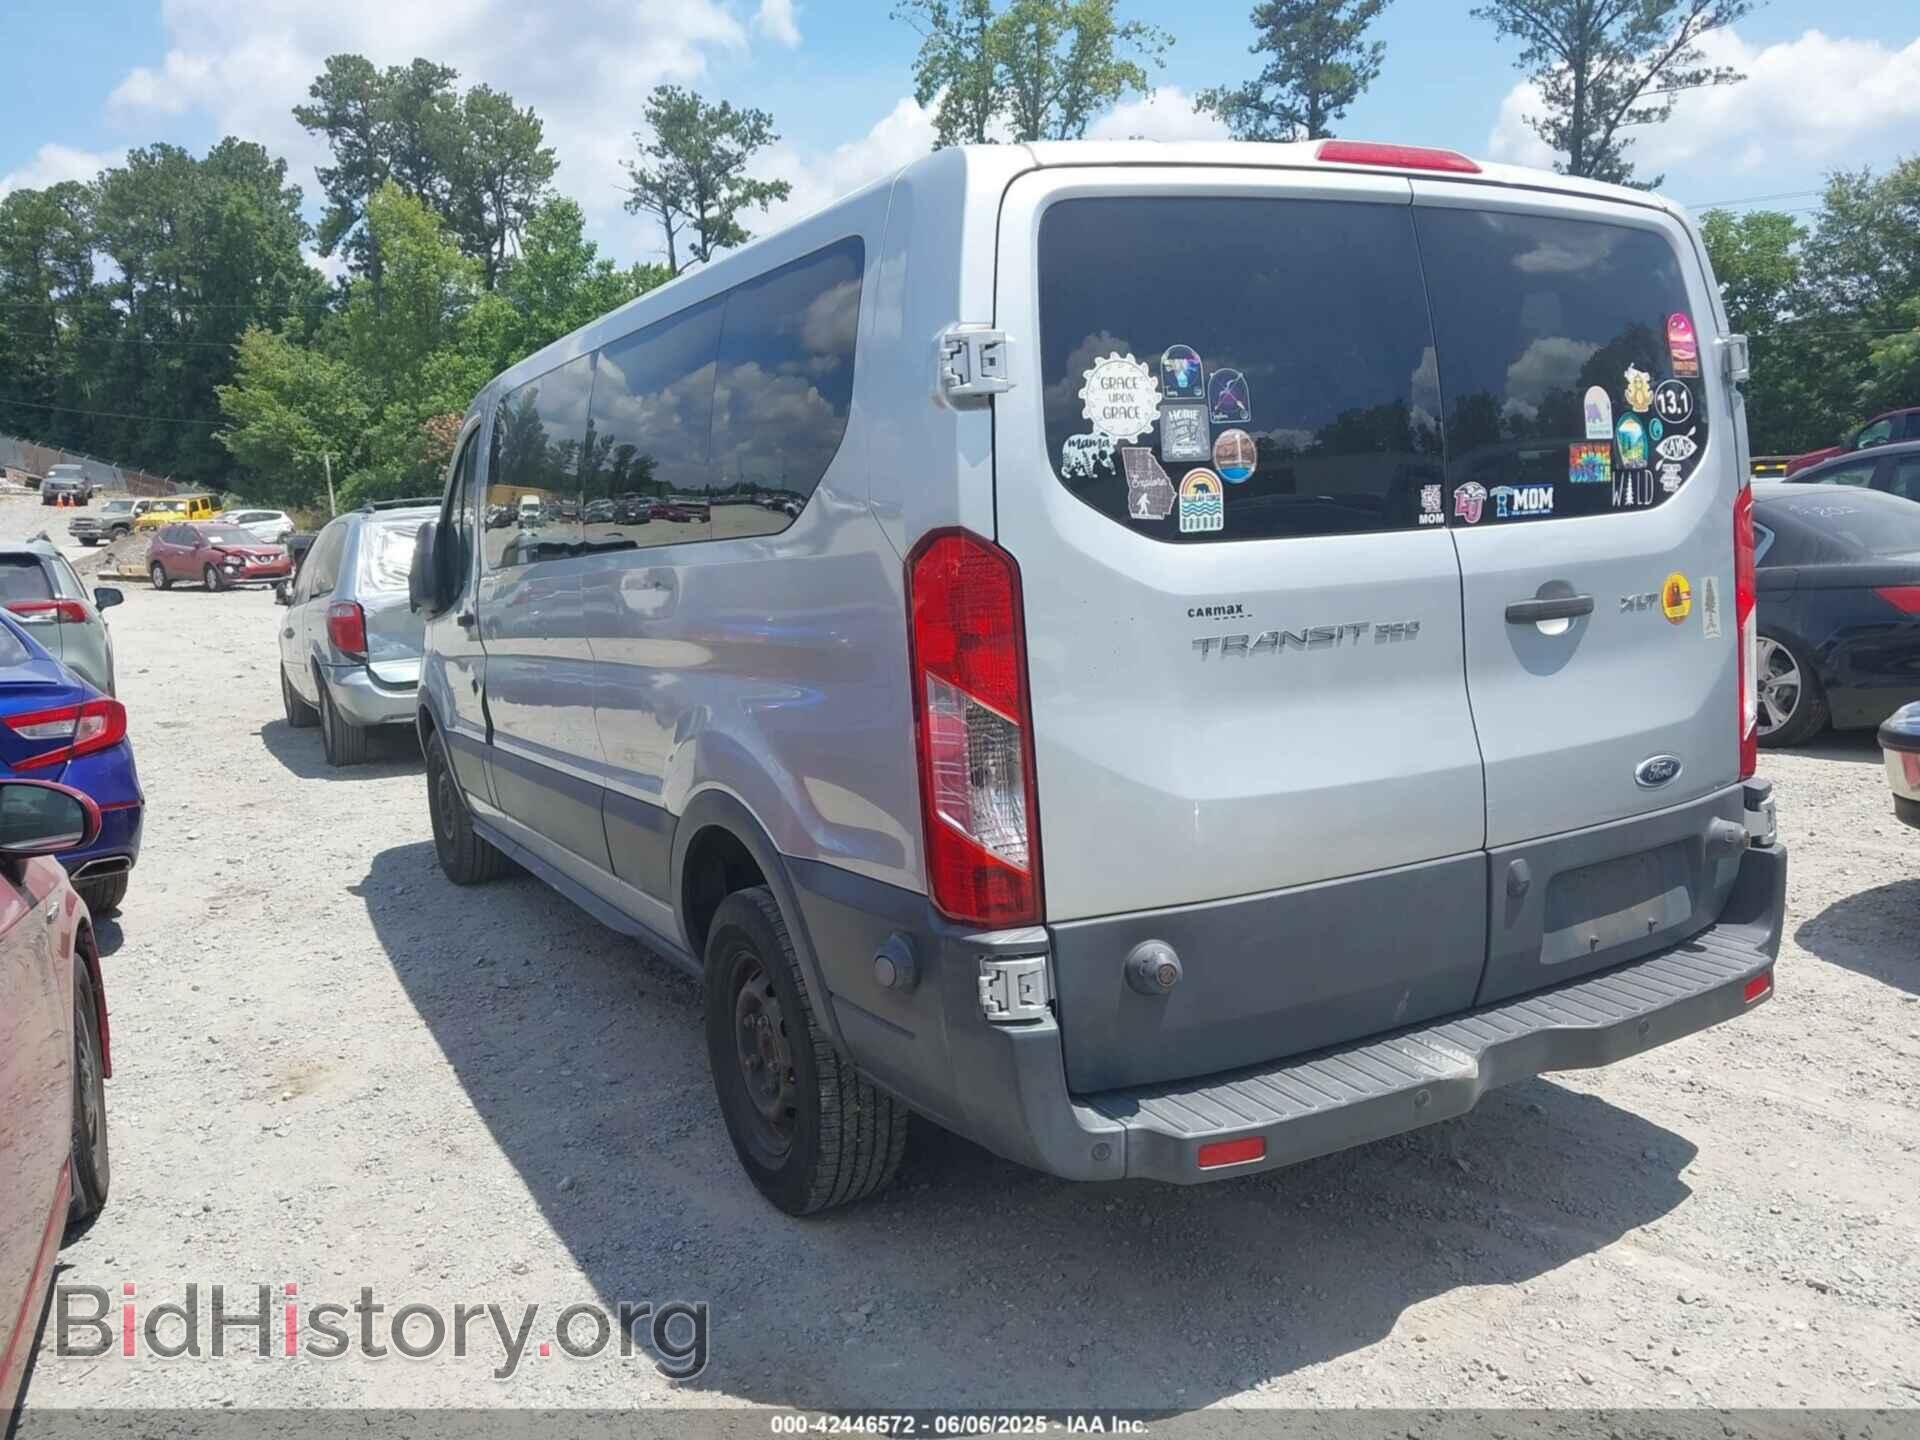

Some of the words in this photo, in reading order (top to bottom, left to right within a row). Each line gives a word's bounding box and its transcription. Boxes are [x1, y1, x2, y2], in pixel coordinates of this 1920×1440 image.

[1100, 376, 1138, 390] GRACE
[1108, 393, 1135, 403] UPON
[1657, 393, 1689, 415] 13.1
[1102, 406, 1140, 420] GRACE
[1513, 487, 1553, 511] MOM
[1419, 513, 1445, 524] MOM
[1192, 621, 1370, 660] TRANSIT
